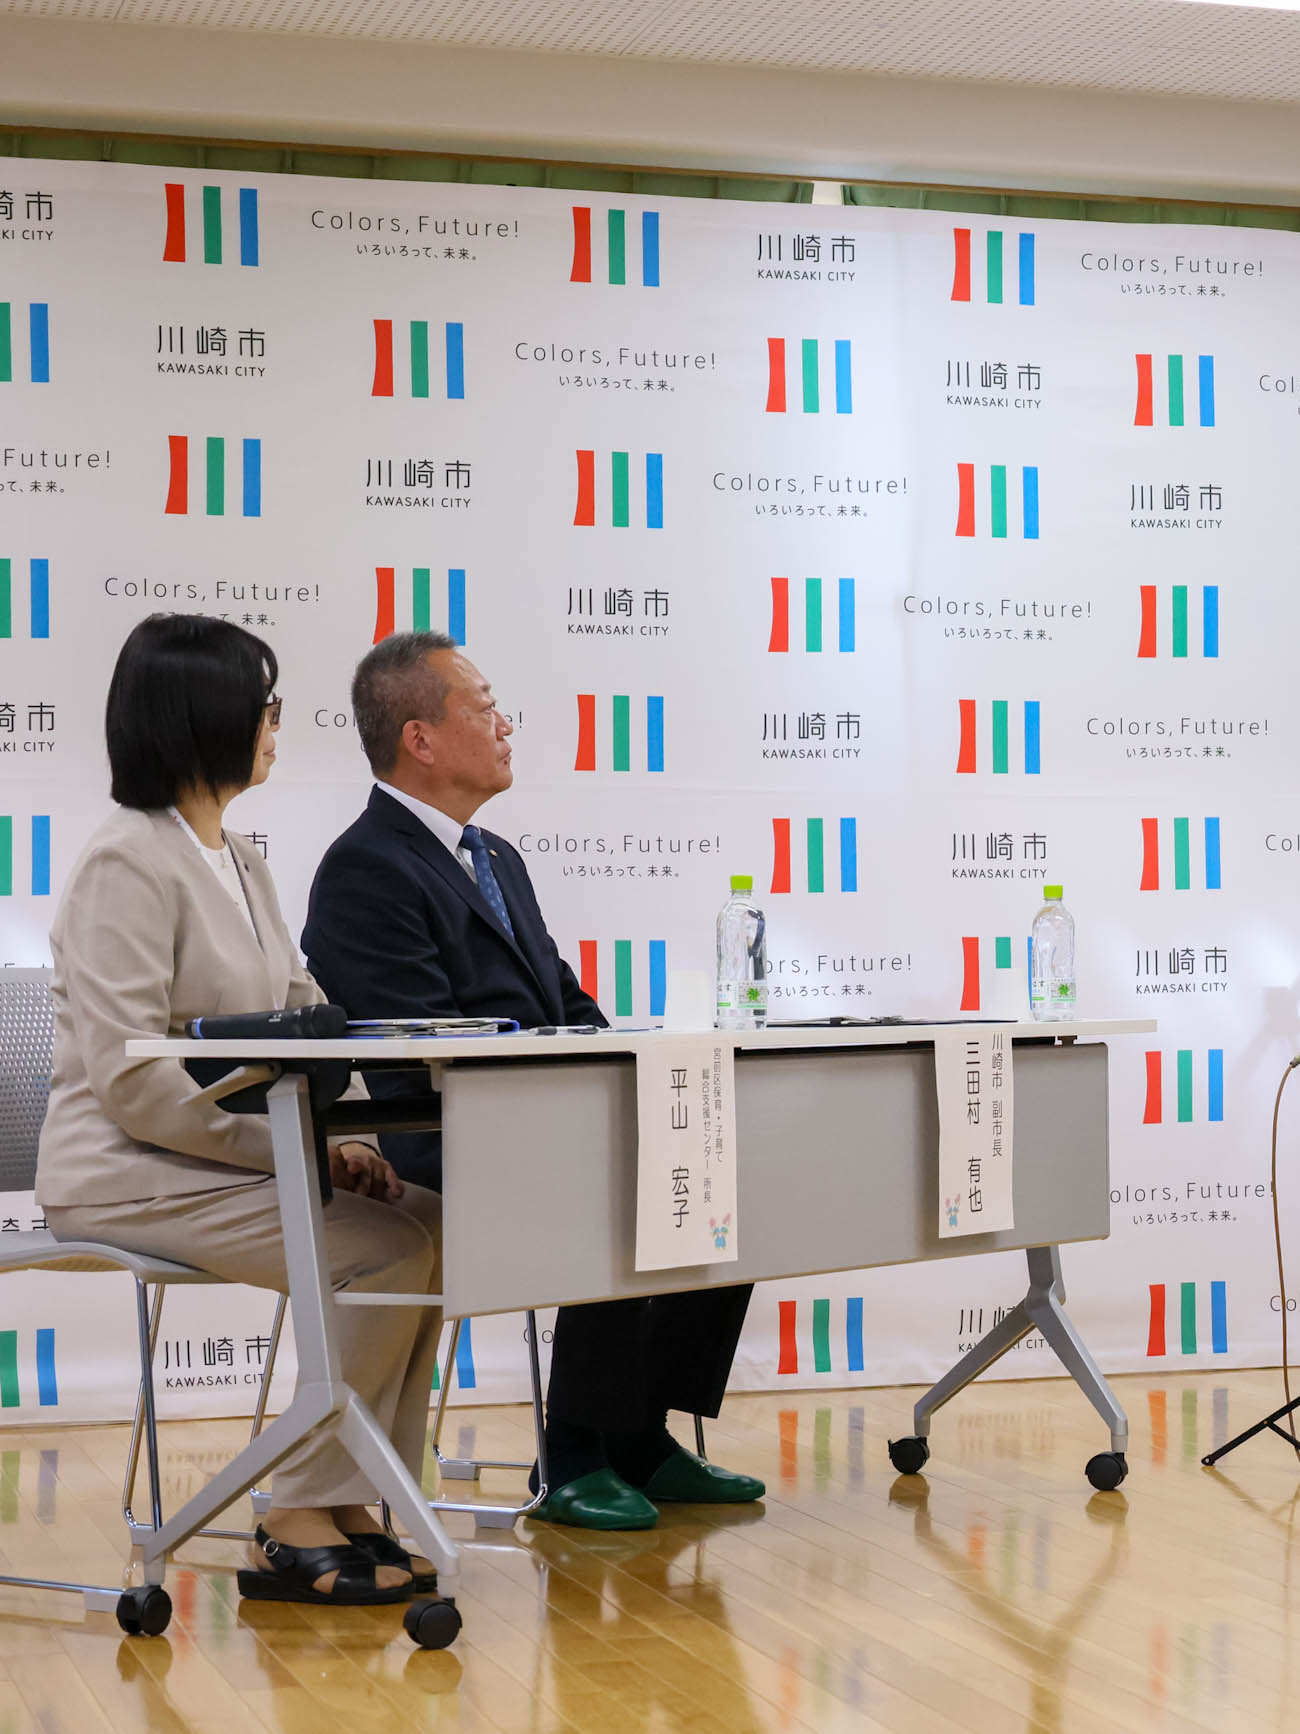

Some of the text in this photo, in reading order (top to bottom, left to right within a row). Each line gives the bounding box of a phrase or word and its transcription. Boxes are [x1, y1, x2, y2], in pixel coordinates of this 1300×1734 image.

[311, 209, 519, 239] Colors, Future!
[22, 229, 54, 241] CITY
[356, 243, 477, 261] いろいろって、未来。
[757, 233, 857, 264] 川崎市
[1080, 252, 1263, 277] Colors, Future!
[757, 268, 856, 282] KAWASAKI CITY
[1120, 283, 1226, 298] いろいろって、未来。
[156, 324, 266, 359] 川崎市
[514, 342, 716, 371] Colors, Future!
[157, 361, 267, 378] KAWASAKI CITY
[946, 359, 1041, 392] 川崎市
[559, 375, 675, 393] いろいろって、未来。
[946, 394, 1042, 409] KAWASAKI CITY
[4, 448, 110, 469] Future!
[365, 458, 472, 490] 川崎市
[712, 472, 907, 496] Colors, Future!
[365, 495, 472, 509] KAWASAKI CITY
[1130, 482, 1223, 512] 川崎市
[755, 503, 868, 518] いろいろって、未来。
[1130, 518, 1223, 529] KAWASAKI CITY
[104, 576, 319, 603] Colors, Future!
[567, 586, 670, 619] 川崎市
[903, 595, 1091, 619] Colors, Future!
[567, 623, 670, 637] KAWASAKI CITY
[944, 627, 1053, 641] いろいろって、未来。
[761, 711, 862, 742] 川崎市
[1086, 716, 1268, 737] Colors, Future!
[24, 741, 55, 752] CITY
[762, 747, 861, 760] KAWASAKI CITY
[1126, 745, 1232, 759] いろいろって、未来。
[518, 833, 720, 855] Colors, Future!
[951, 831, 1048, 862] 川崎市
[562, 863, 680, 878] いろいろって、未来。
[951, 868, 1048, 880] KAWASAKI CITY
[817, 953, 912, 972] Future!
[1135, 945, 1228, 977] 川崎市
[767, 983, 873, 998] ろいろって、未来。
[1135, 981, 1228, 995] KAWASAKI CITY
[991, 1034, 1003, 1158] 川崎市 副市長
[966, 1042, 983, 1213] 三田村 有也
[671, 1069, 690, 1228] 平山 宏子
[1109, 1184, 1179, 1204] olors,
[1132, 1209, 1238, 1225] いろいろって、未来。
[165, 1375, 237, 1388] KAWASAKI
